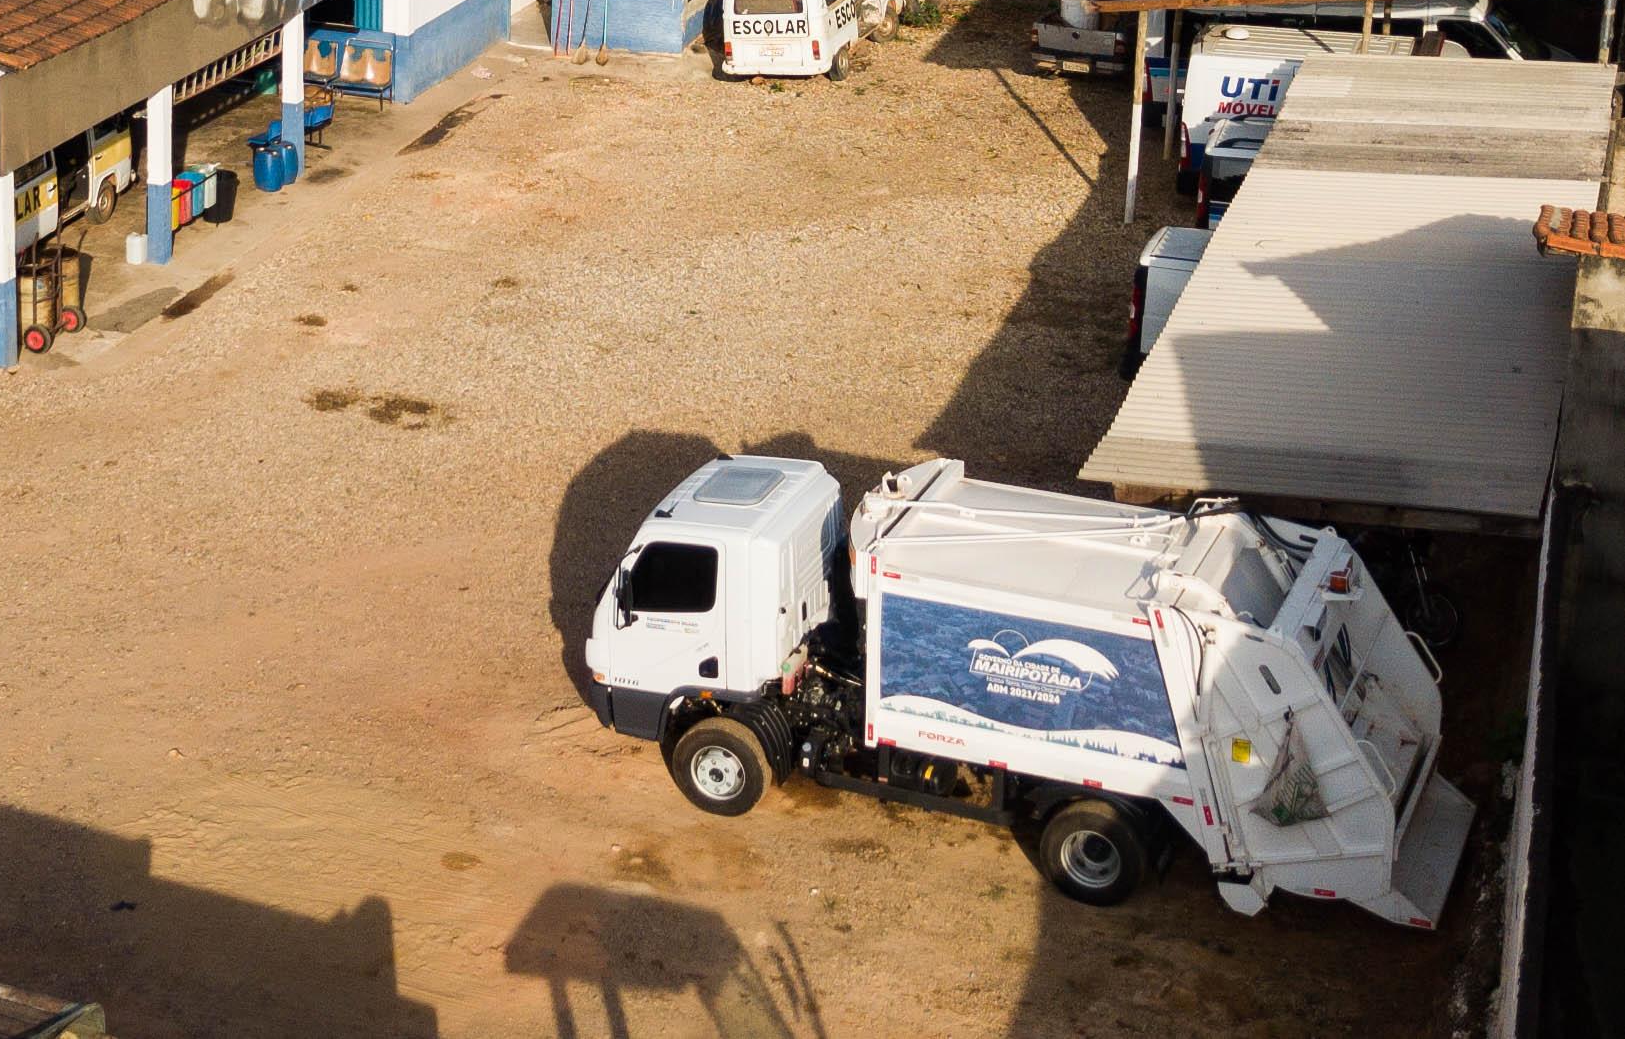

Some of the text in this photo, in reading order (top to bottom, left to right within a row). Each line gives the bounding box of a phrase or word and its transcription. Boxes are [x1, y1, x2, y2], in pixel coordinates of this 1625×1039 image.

[732, 19, 807, 36] ESCOLAR
[974, 659, 1082, 689] MAIRIPOTABA
[978, 653, 1061, 674] GOVERNO DA CIDADE DE
[986, 682, 1061, 705] ADM 2021/2024
